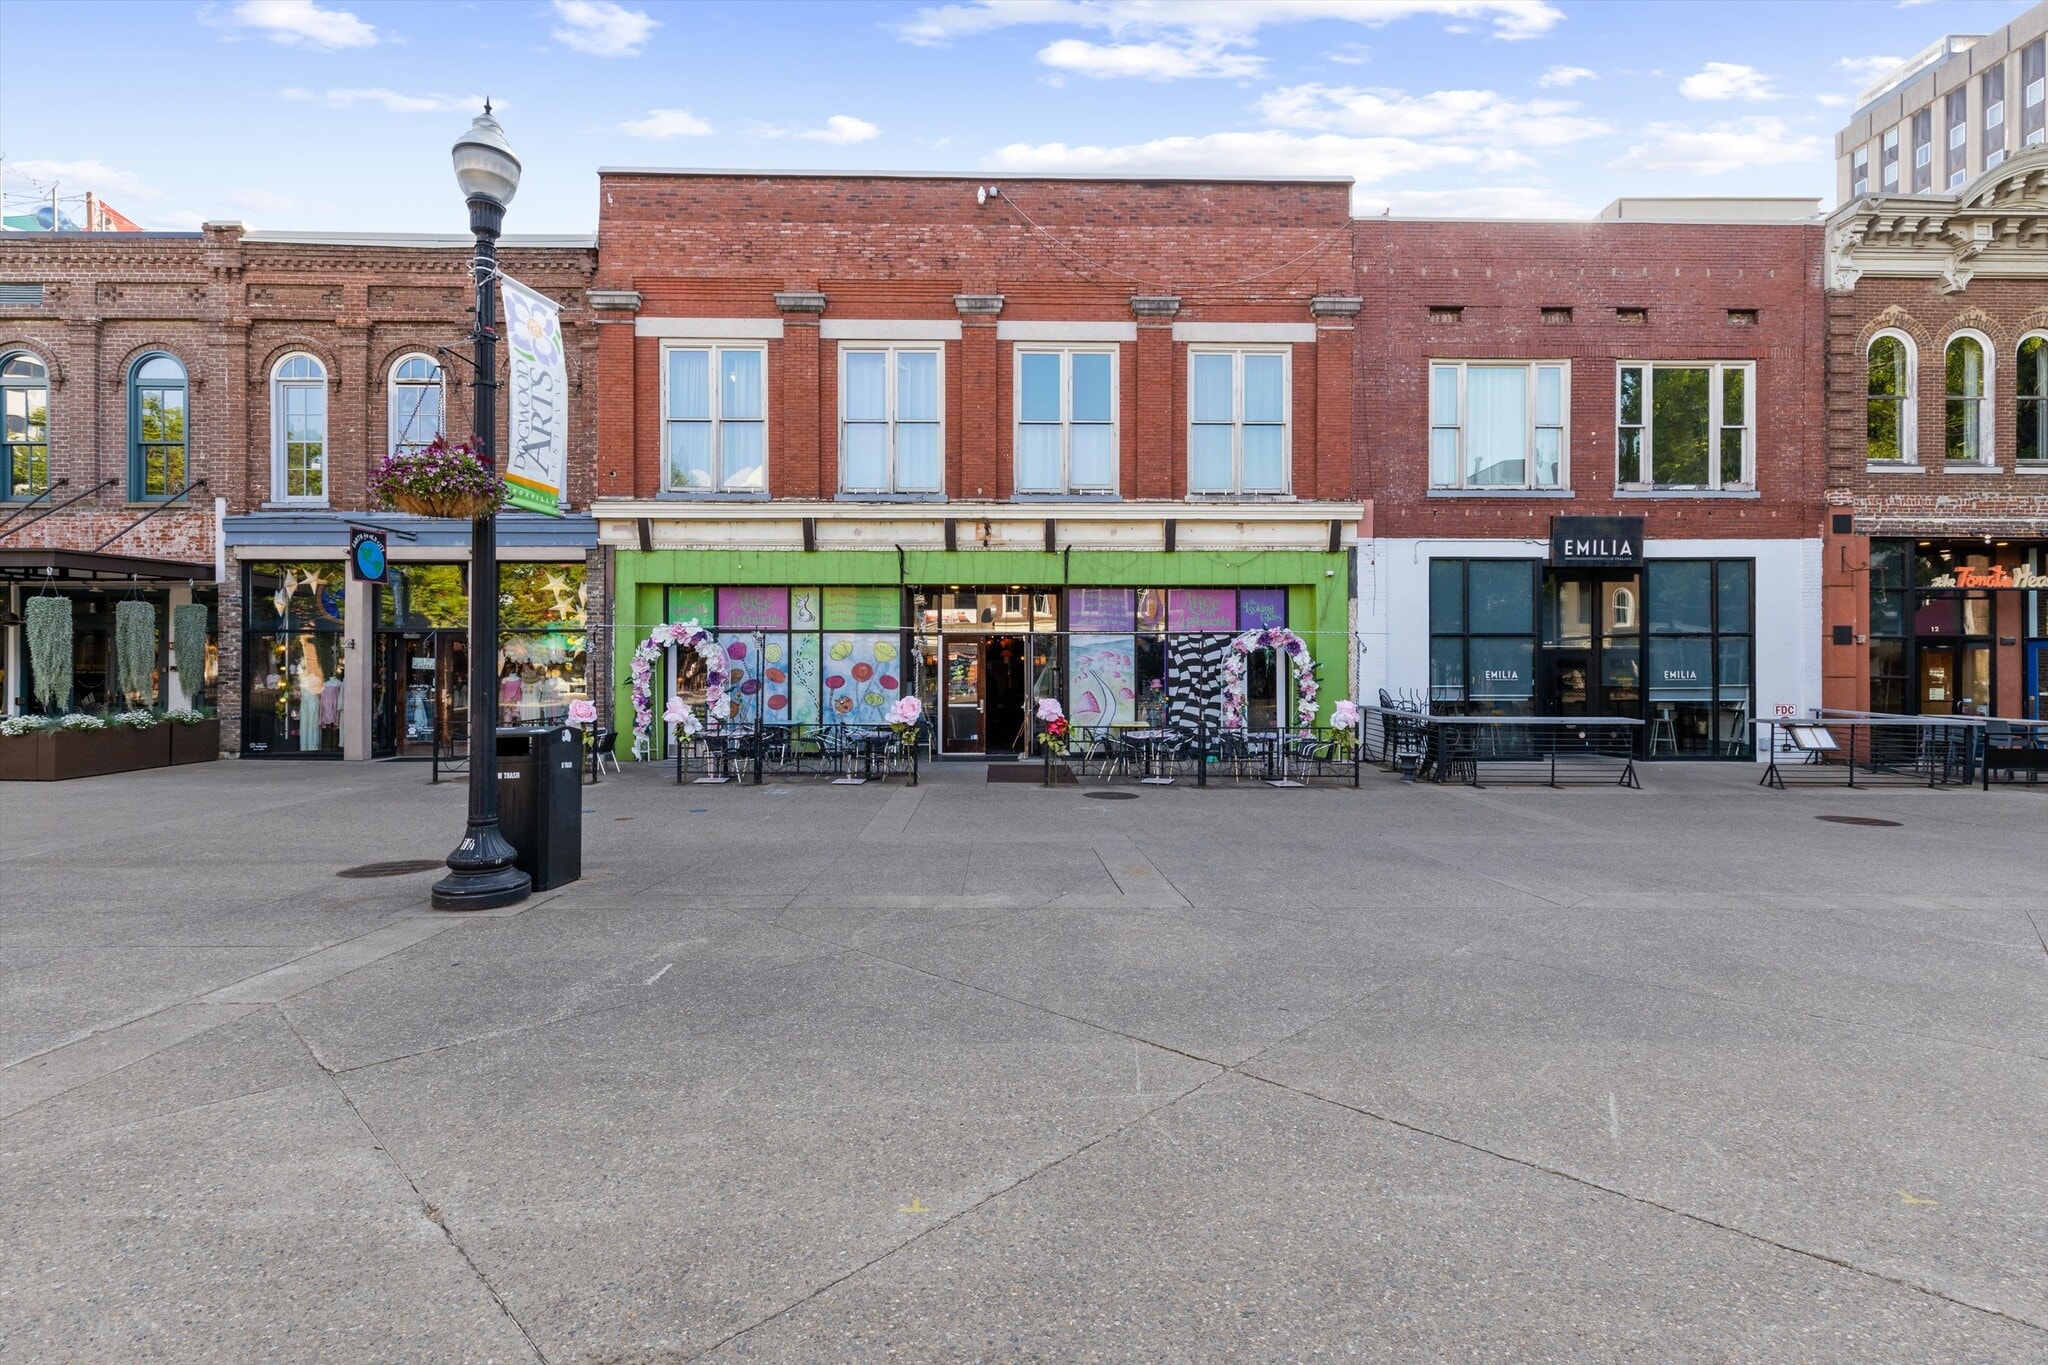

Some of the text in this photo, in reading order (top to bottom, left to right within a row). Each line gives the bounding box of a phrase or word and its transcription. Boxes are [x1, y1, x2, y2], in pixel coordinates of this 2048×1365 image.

[514, 359, 531, 470] DOGWOOD
[521, 367, 553, 478] ARTS
[512, 488, 556, 506] NOXVILLE
[1564, 539, 1632, 556] EMILIA
[2012, 563, 2048, 588] Hea
[729, 591, 773, 614] Alice
[1183, 591, 1220, 615] Alice
[1243, 601, 1275, 616] Looking
[1260, 612, 1282, 623] Glass
[1485, 671, 1518, 679] EMILIA
[1664, 670, 1697, 679] EMILIA
[1775, 705, 1794, 714] FDC
